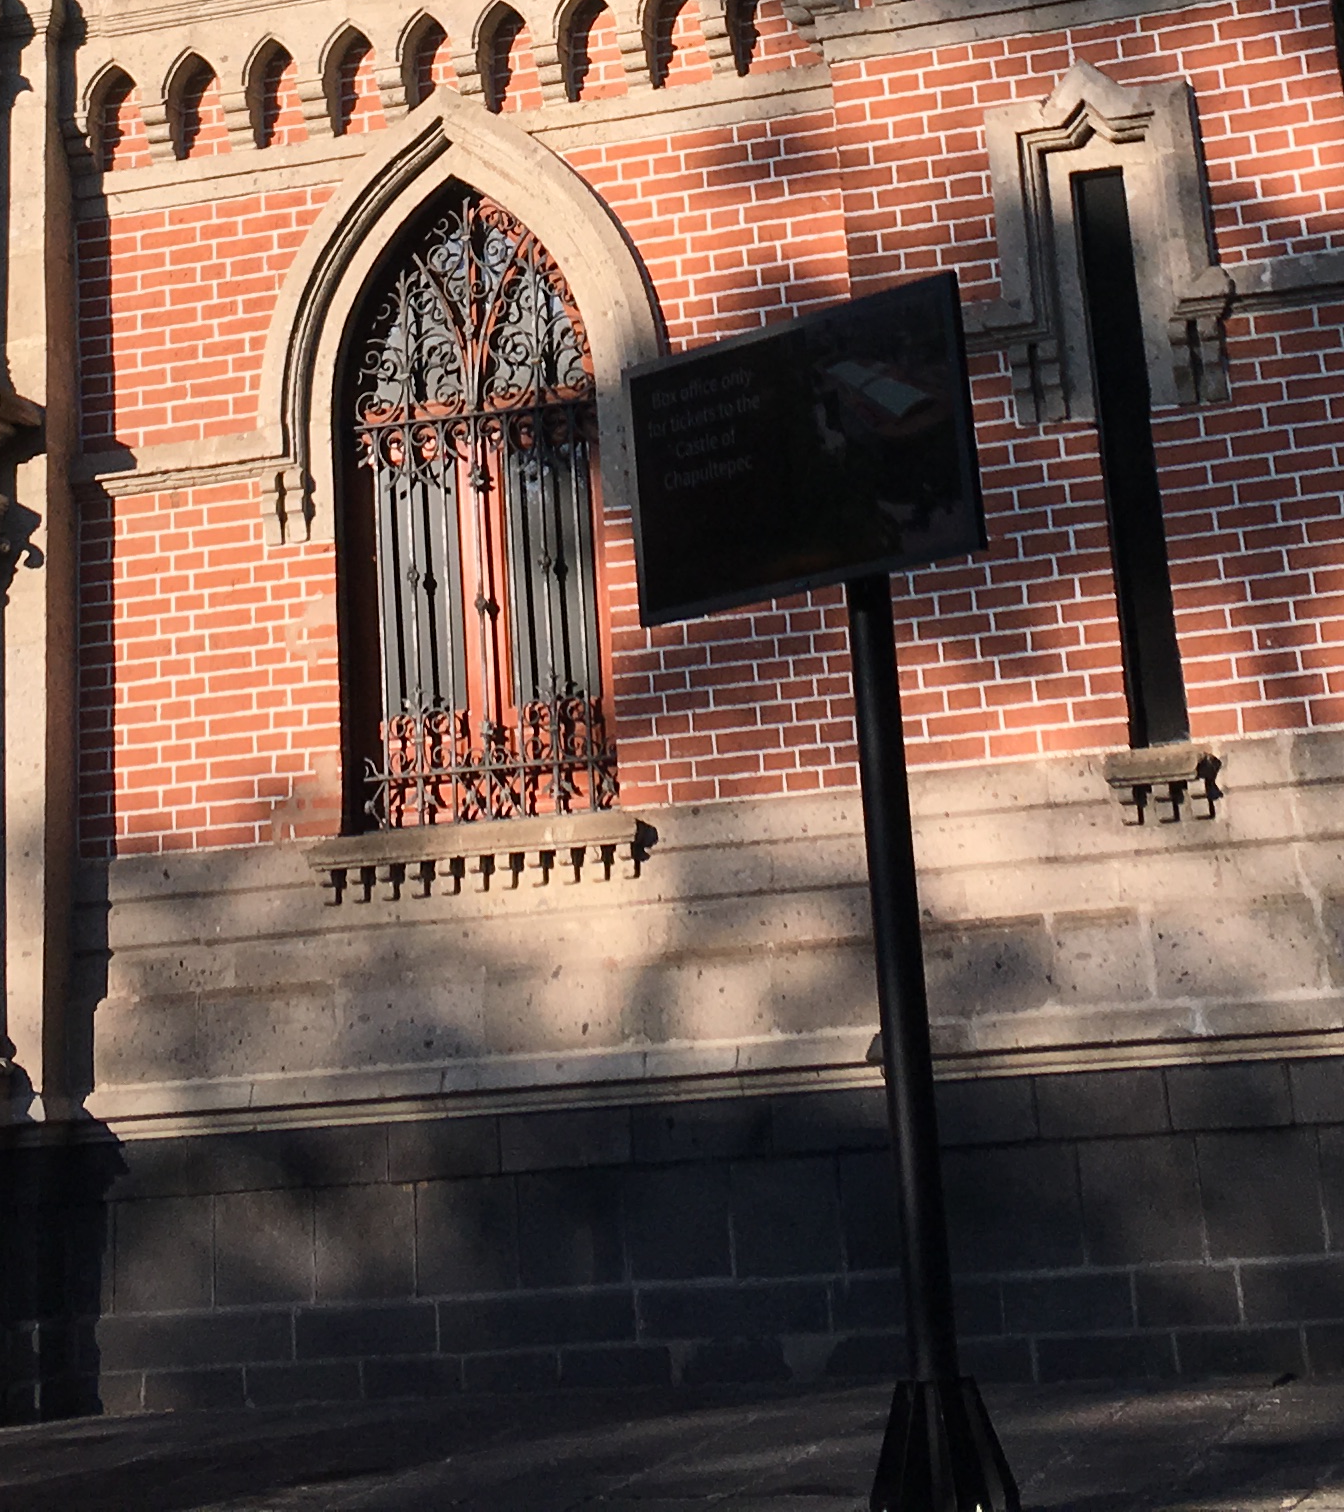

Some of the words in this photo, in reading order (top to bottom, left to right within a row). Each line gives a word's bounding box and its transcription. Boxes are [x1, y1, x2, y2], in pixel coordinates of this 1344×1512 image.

[651, 390, 677, 410] Box
[680, 378, 718, 402] office
[721, 366, 753, 389] only
[647, 419, 667, 439] for
[670, 408, 716, 432] tickets
[719, 402, 734, 419] to
[736, 393, 761, 413] the
[675, 432, 719, 459] Castle
[721, 427, 736, 447] of
[663, 455, 753, 491] Chapultepec
